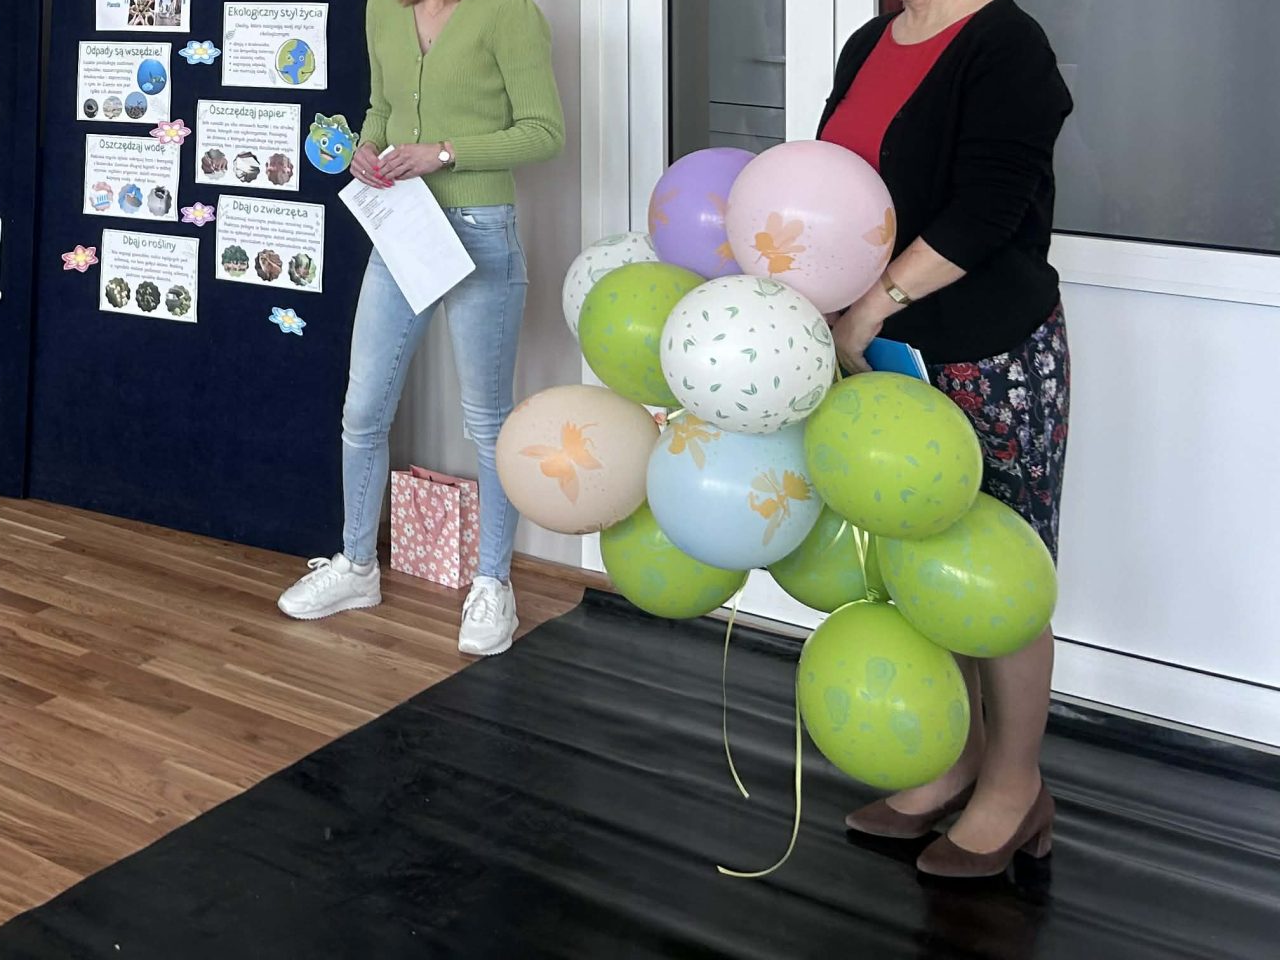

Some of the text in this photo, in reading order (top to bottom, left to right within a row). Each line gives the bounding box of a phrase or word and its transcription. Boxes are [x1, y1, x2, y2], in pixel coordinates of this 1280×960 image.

[228, 6, 323, 20] Ekologiczny styl życia
[85, 45, 163, 58] Odpady są wszędzie!
[209, 104, 287, 120] Oszczędzaj papier
[99, 139, 166, 155] Oszczędzaj wodę
[233, 200, 252, 214] Dbaj
[260, 205, 308, 219] zwierzęta
[122, 235, 140, 249] Dbaj
[148, 239, 176, 253] rośliny
